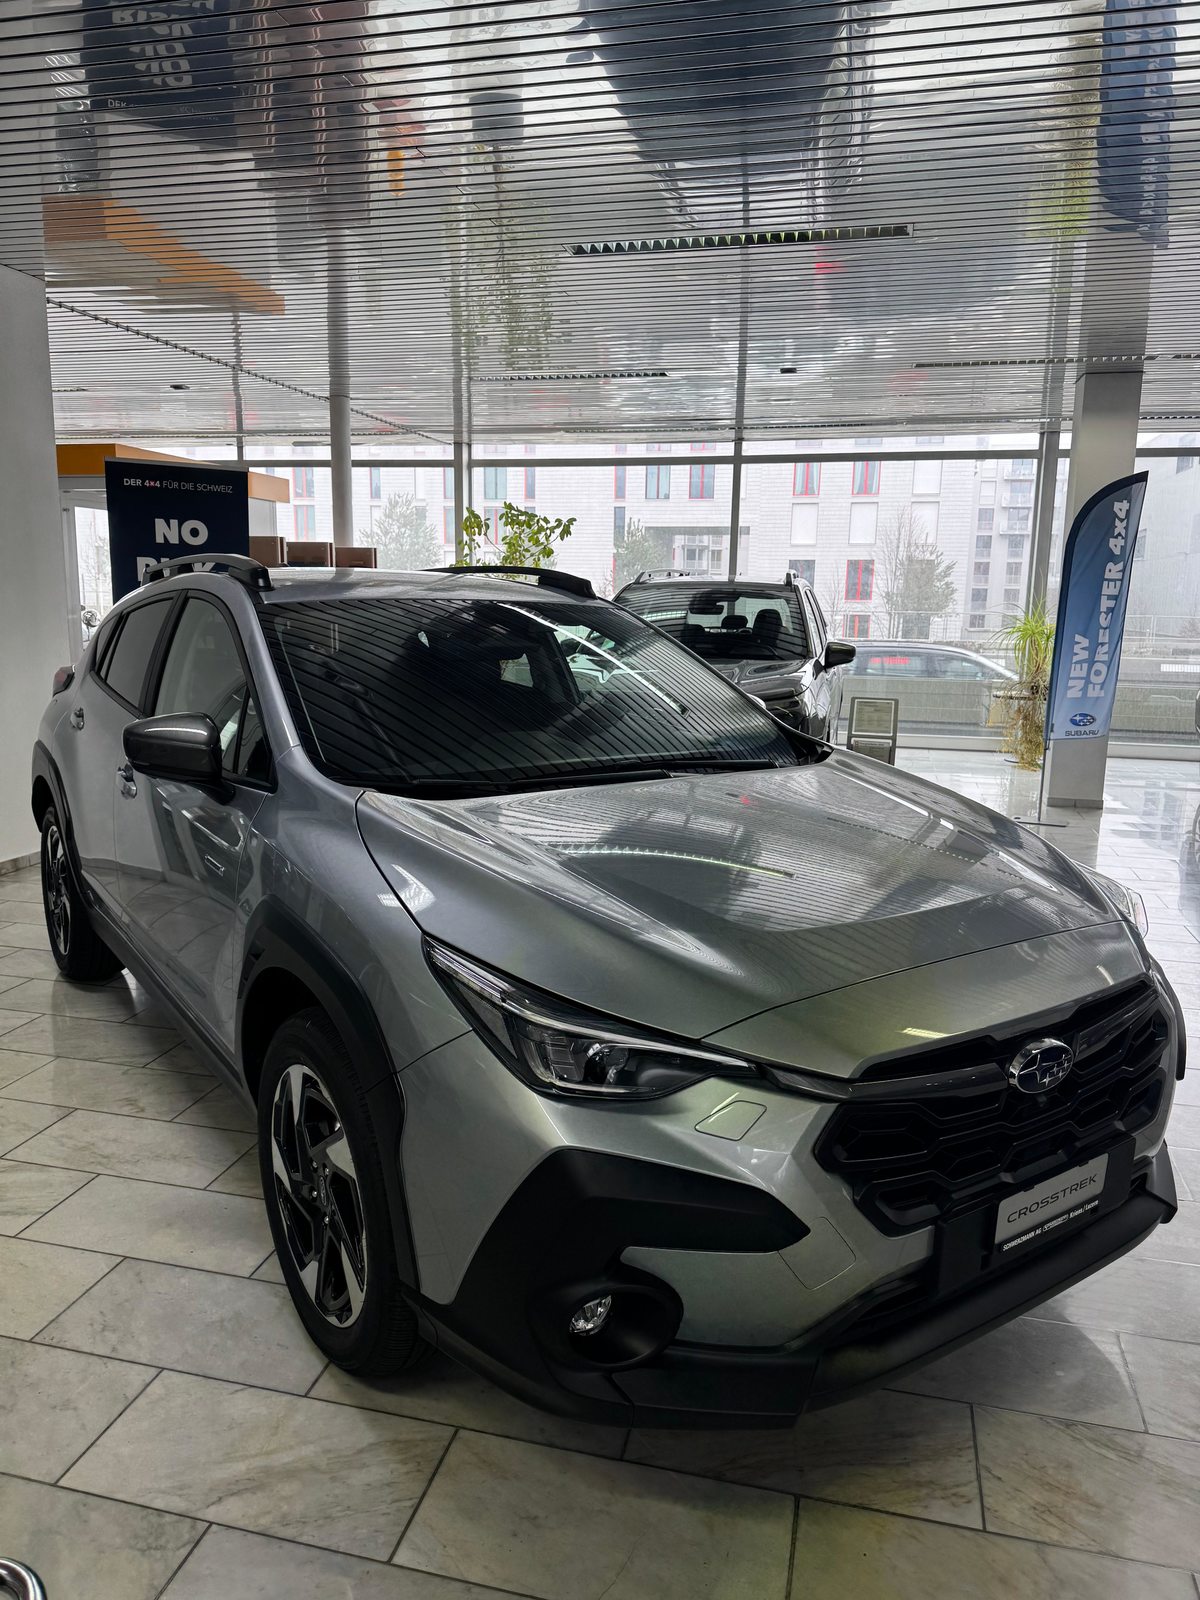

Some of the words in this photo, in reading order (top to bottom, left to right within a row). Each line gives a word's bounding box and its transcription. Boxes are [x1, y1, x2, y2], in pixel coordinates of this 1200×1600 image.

[123, 478, 142, 487] DER
[163, 480, 179, 489] FÜR
[181, 482, 195, 491] DIE
[196, 483, 233, 494] SCHWEIZ
[154, 518, 209, 546] NO
[1087, 560, 1124, 698] FORESTER
[1108, 499, 1131, 555] 4x4
[1066, 633, 1091, 699] NEW
[1064, 729, 1100, 737] SUBARU
[1006, 1173, 1098, 1224] CROSSTREK
